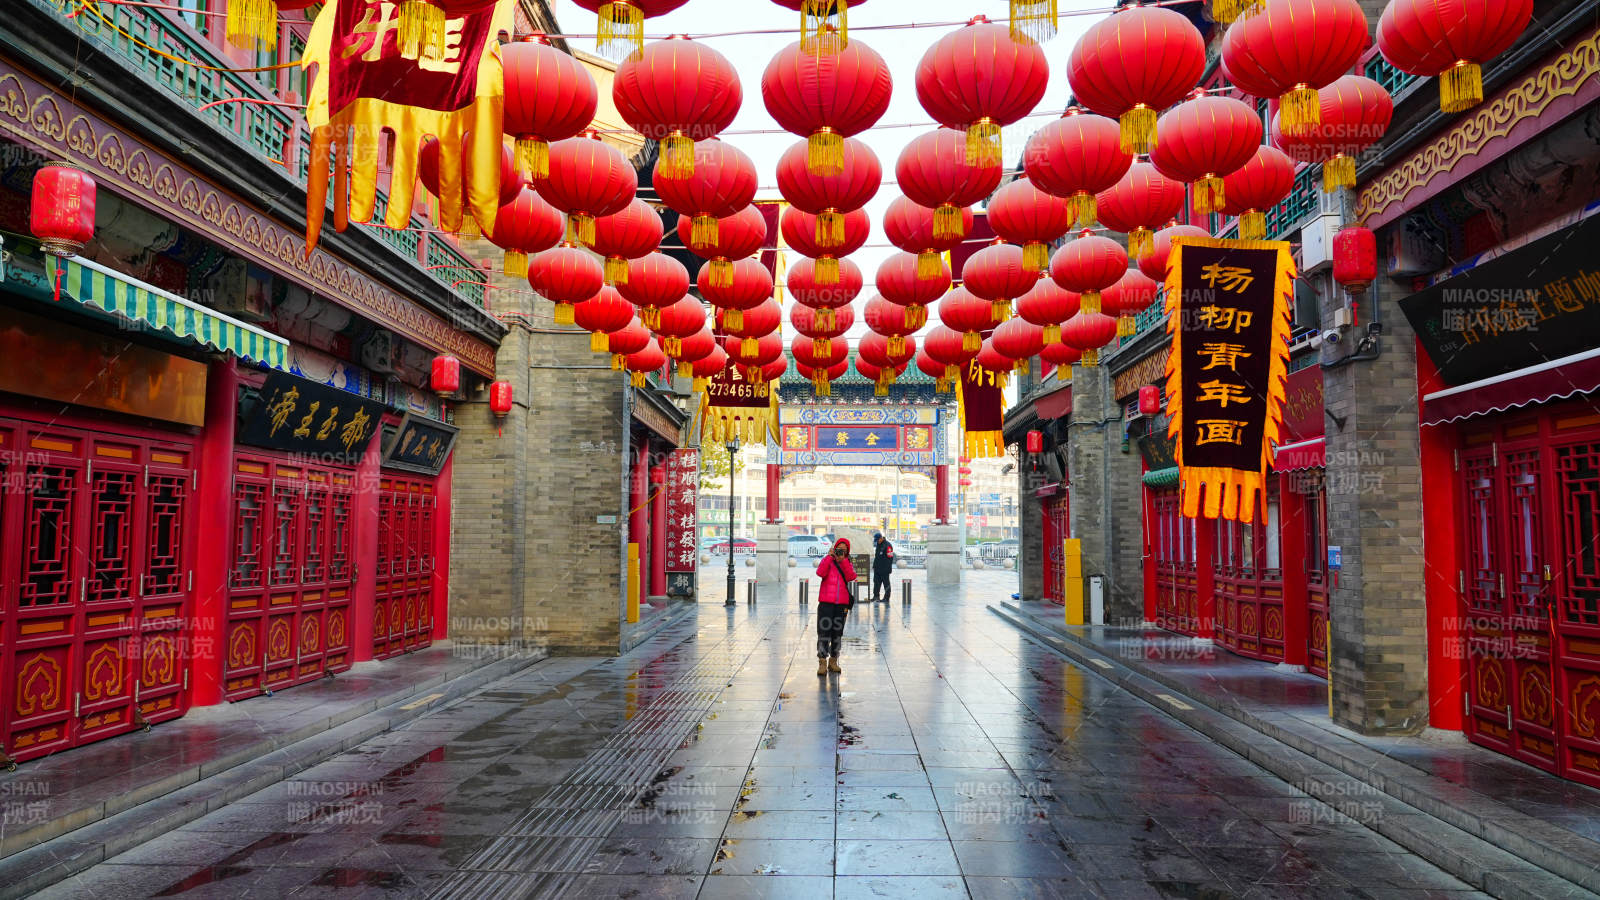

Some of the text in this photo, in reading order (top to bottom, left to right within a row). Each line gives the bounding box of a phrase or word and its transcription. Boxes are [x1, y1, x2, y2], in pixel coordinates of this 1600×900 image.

[1194, 262, 1255, 446] 杨柳青年画
